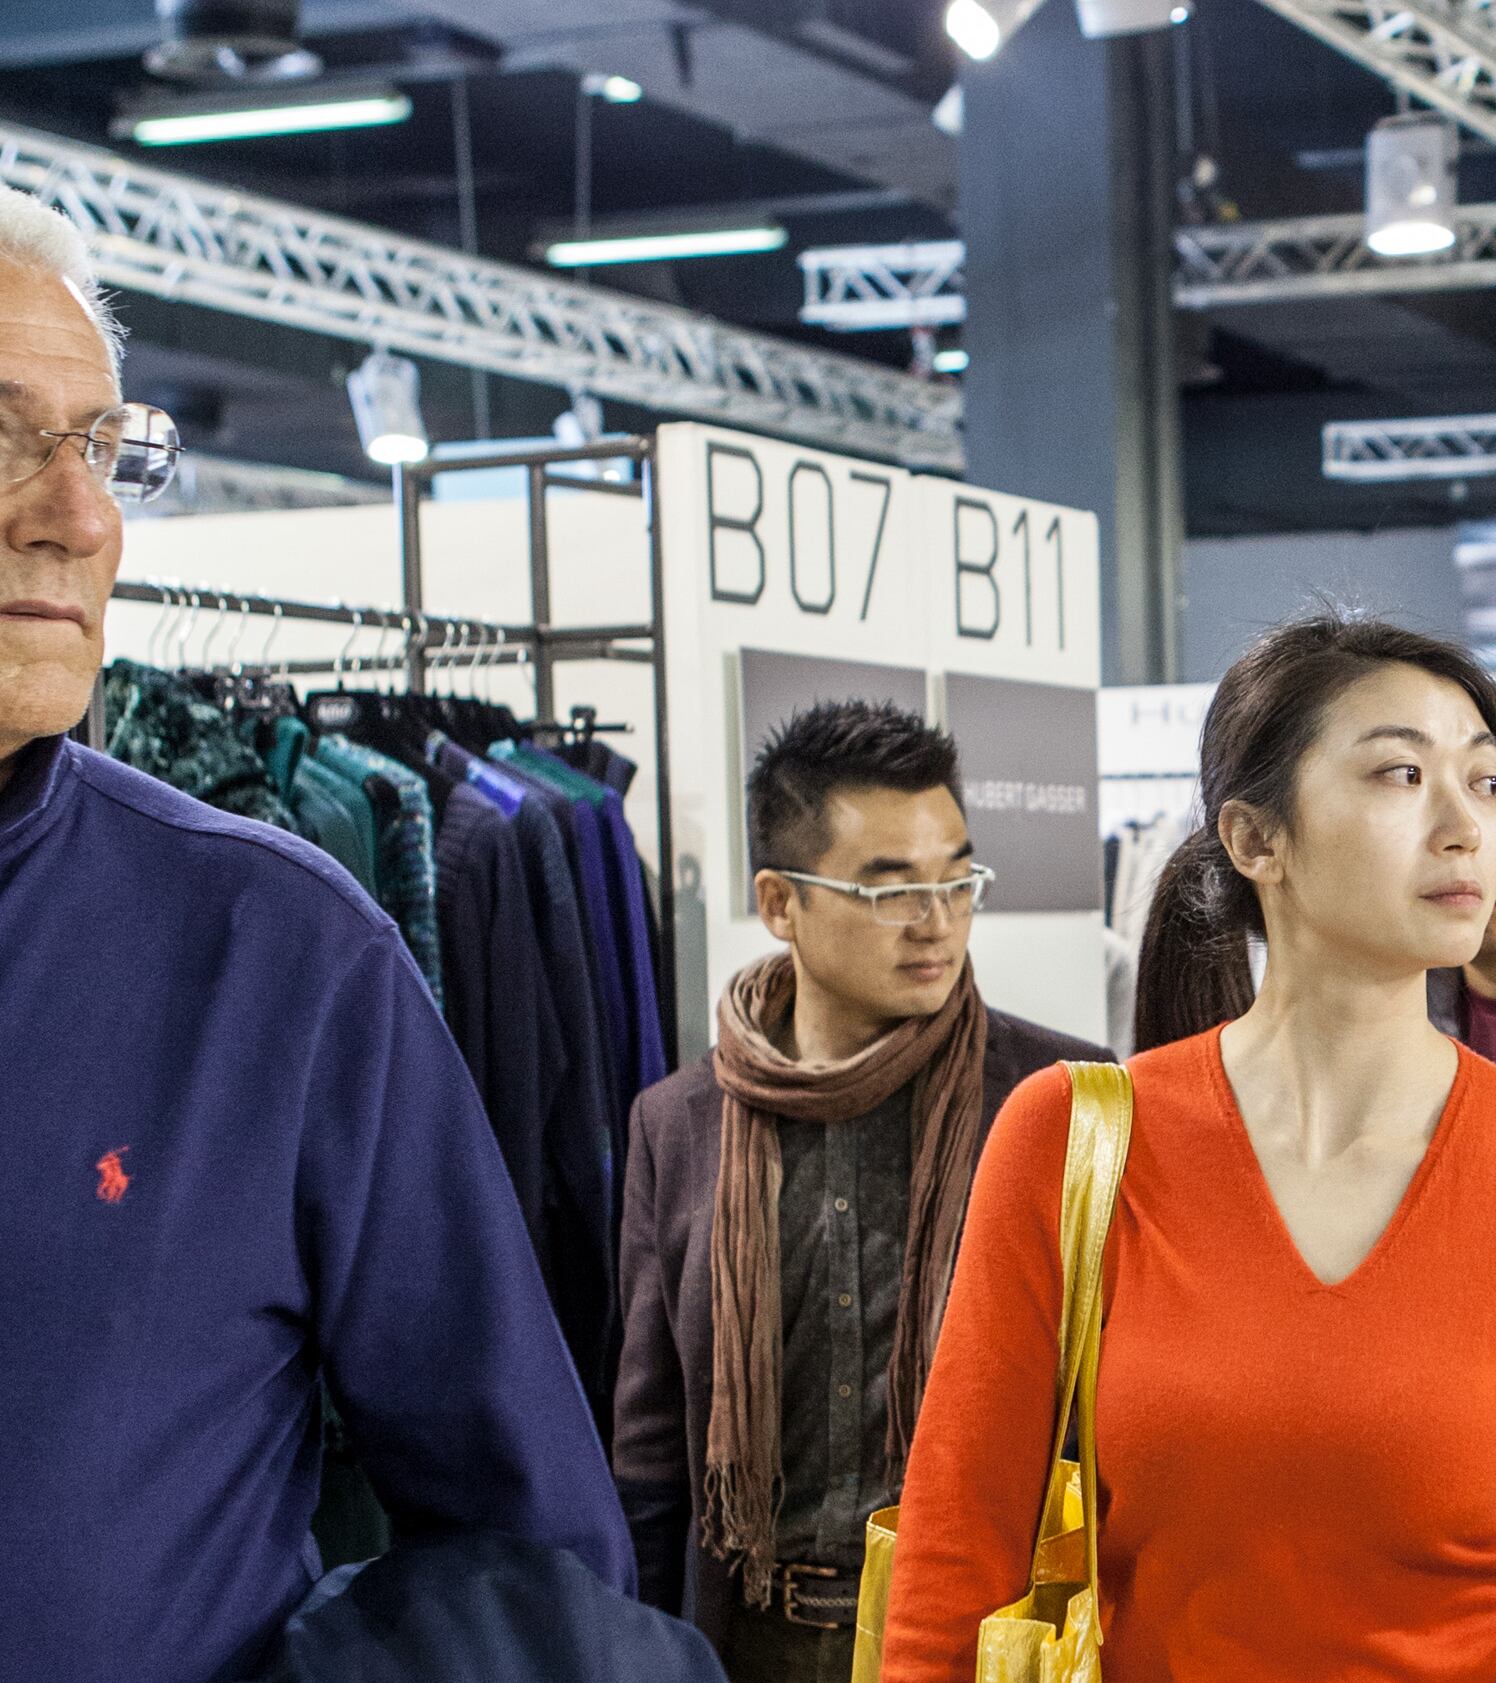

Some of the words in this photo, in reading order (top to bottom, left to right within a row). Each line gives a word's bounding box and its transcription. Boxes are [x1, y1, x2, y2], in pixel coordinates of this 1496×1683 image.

[706, 440, 892, 622] B07
[953, 494, 1066, 652] B11
[963, 780, 1024, 811] HUBERT
[1026, 782, 1087, 814] GASSER
